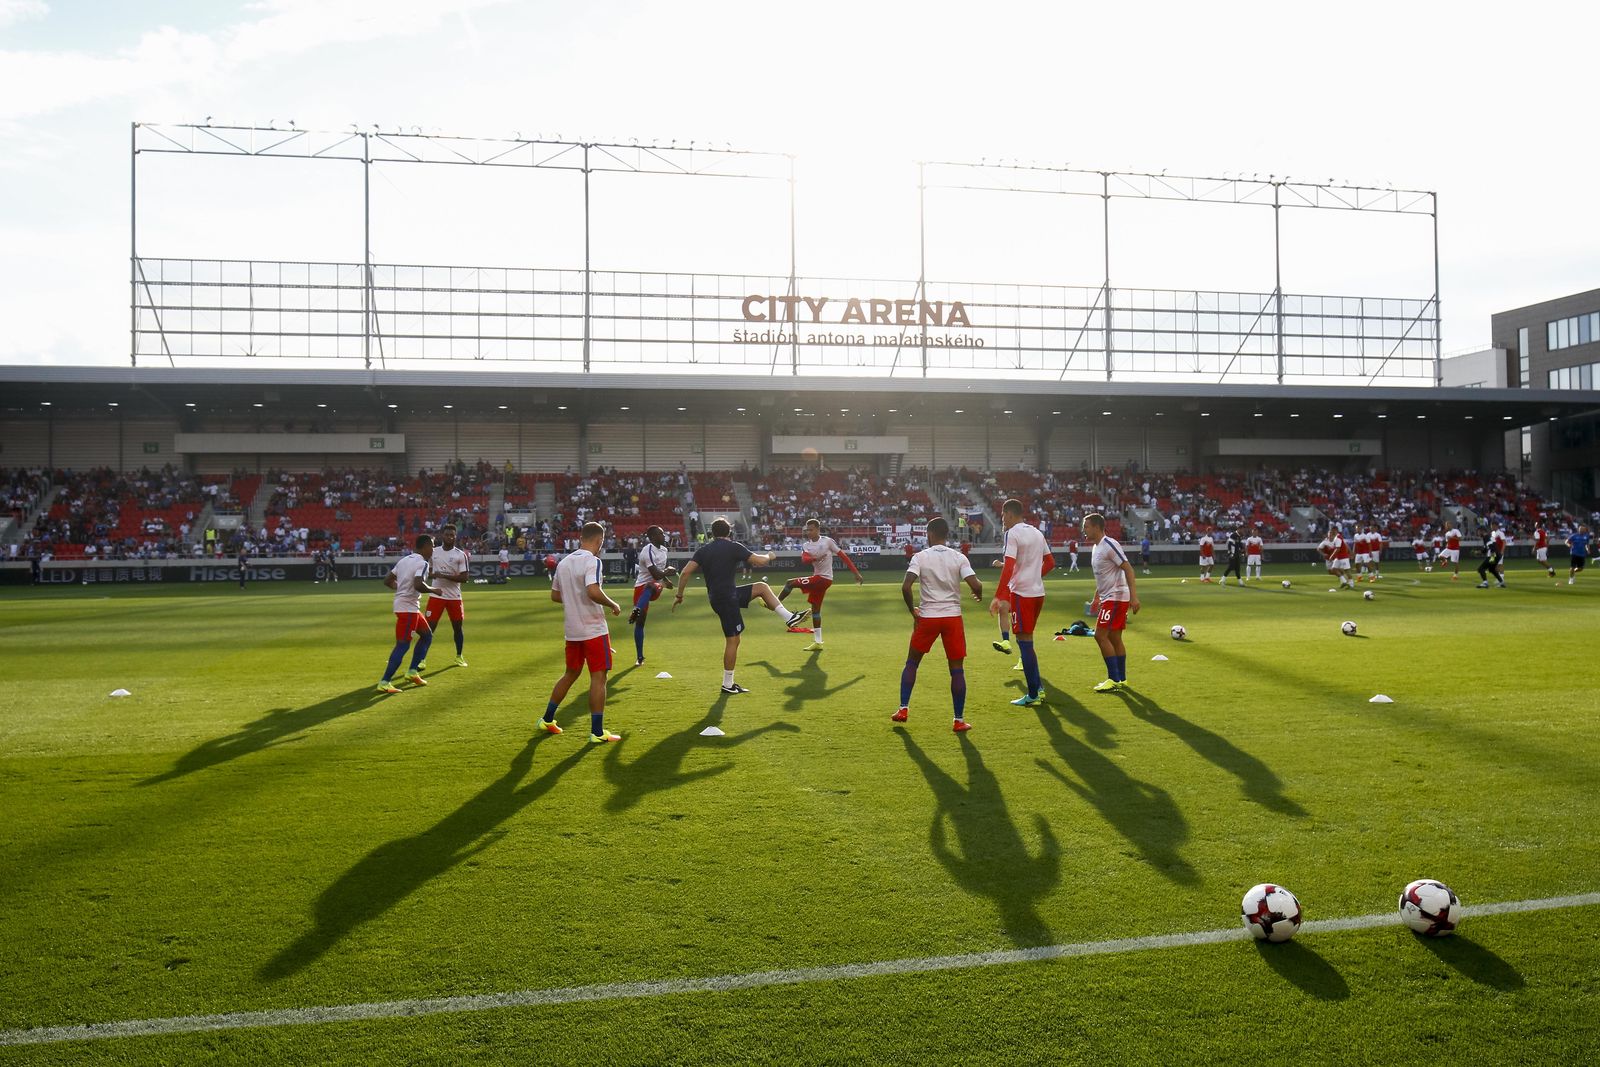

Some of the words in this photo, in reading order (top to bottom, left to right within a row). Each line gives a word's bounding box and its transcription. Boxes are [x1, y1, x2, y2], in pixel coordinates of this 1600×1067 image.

[742, 295, 829, 323] CITY
[840, 297, 972, 327] ARENA
[733, 329, 798, 344] štadión
[807, 331, 865, 345] antona
[873, 332, 985, 348] malatinského
[36, 569, 76, 582] LED
[190, 566, 286, 581] Hisense
[469, 563, 535, 576] sense
[1100, 608, 1111, 621] 16
